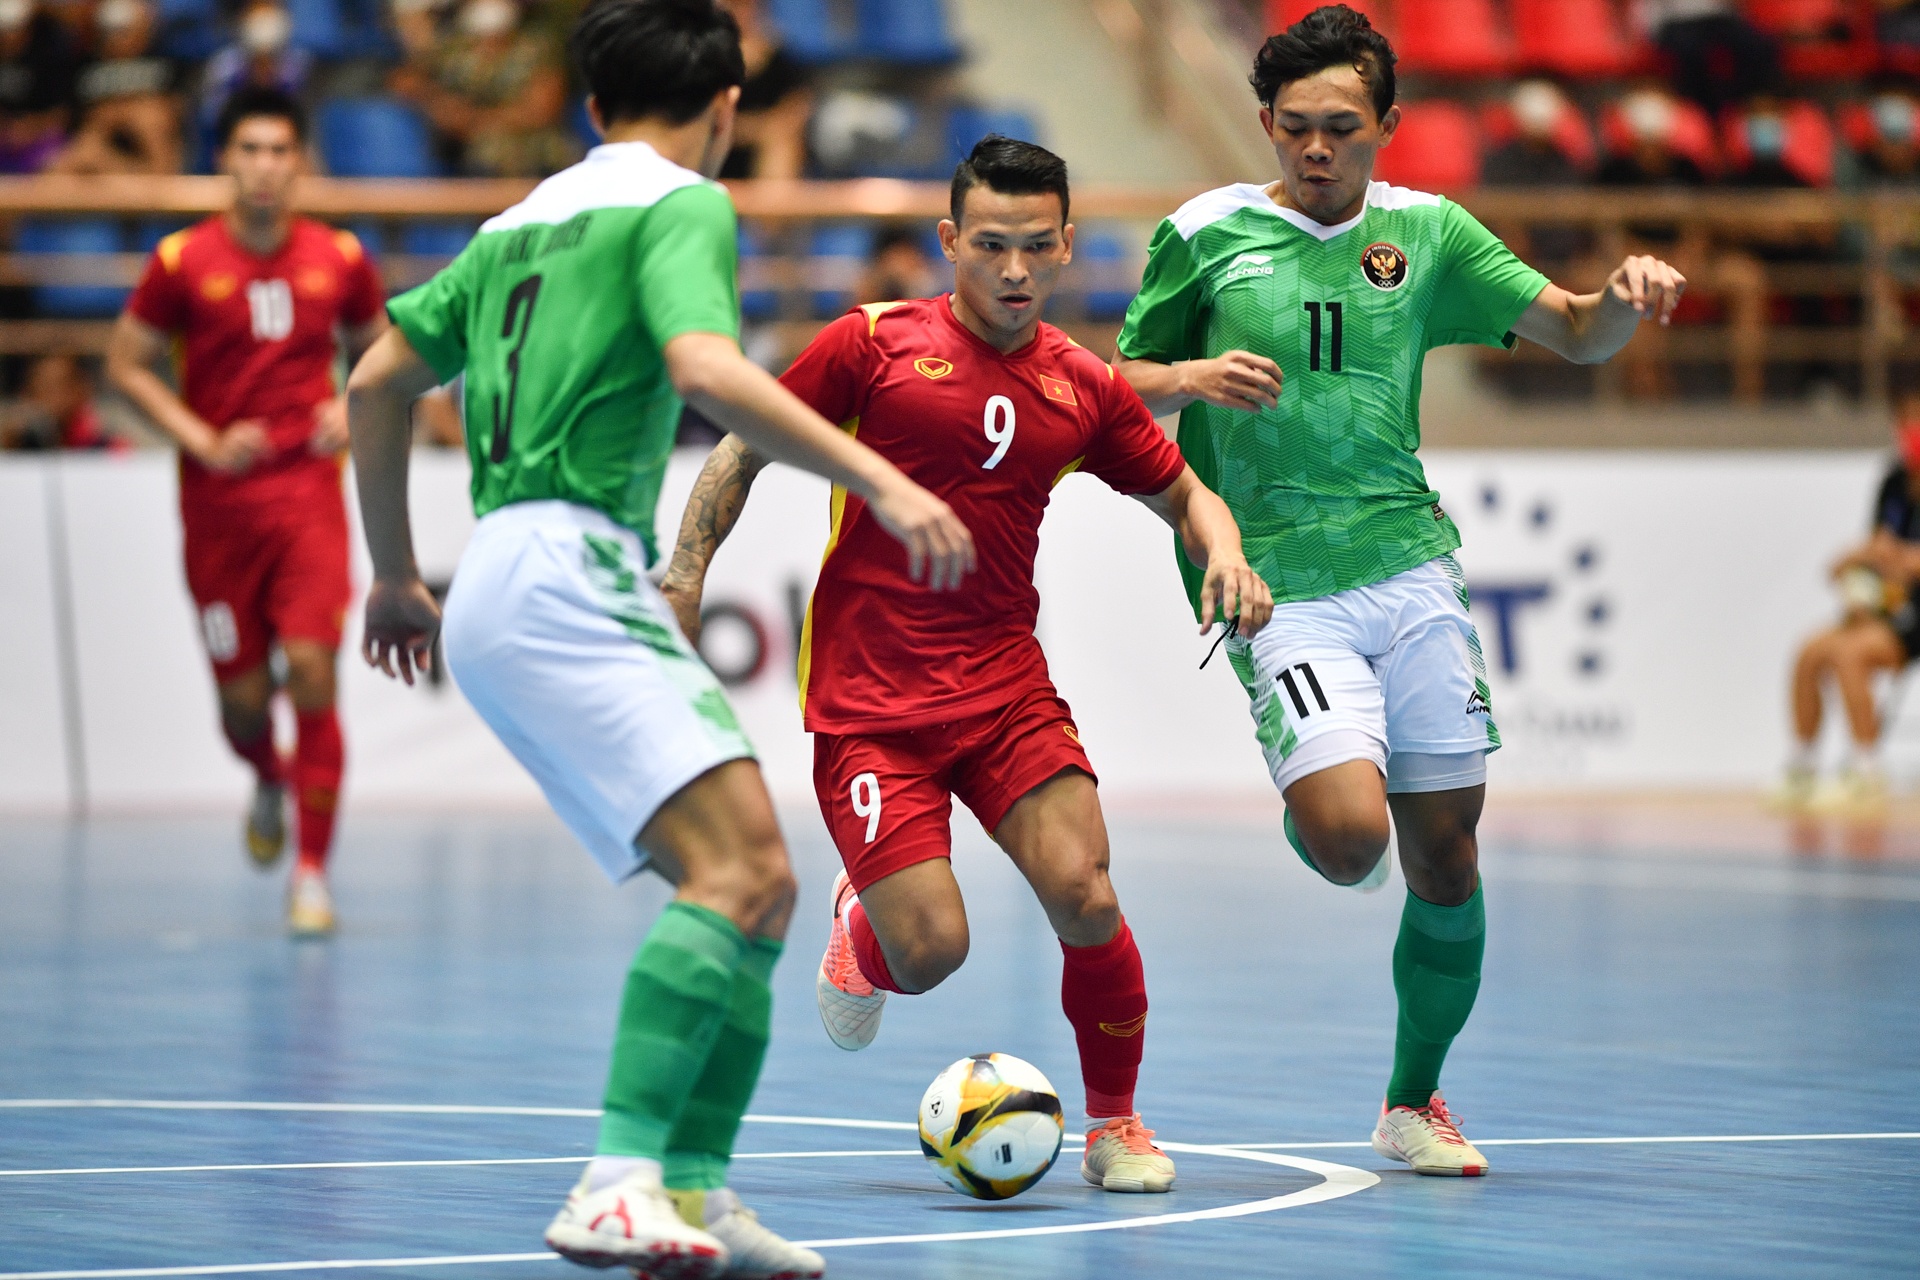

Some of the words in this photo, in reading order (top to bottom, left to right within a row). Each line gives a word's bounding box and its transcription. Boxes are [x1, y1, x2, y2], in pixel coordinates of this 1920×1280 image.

[1226, 267, 1274, 279] LI-NING
[246, 279, 294, 341] 10
[1304, 302, 1342, 372] 11
[490, 274, 543, 464] 3
[981, 395, 1016, 470] 9
[1275, 662, 1331, 719] 11
[849, 773, 882, 844] 9
